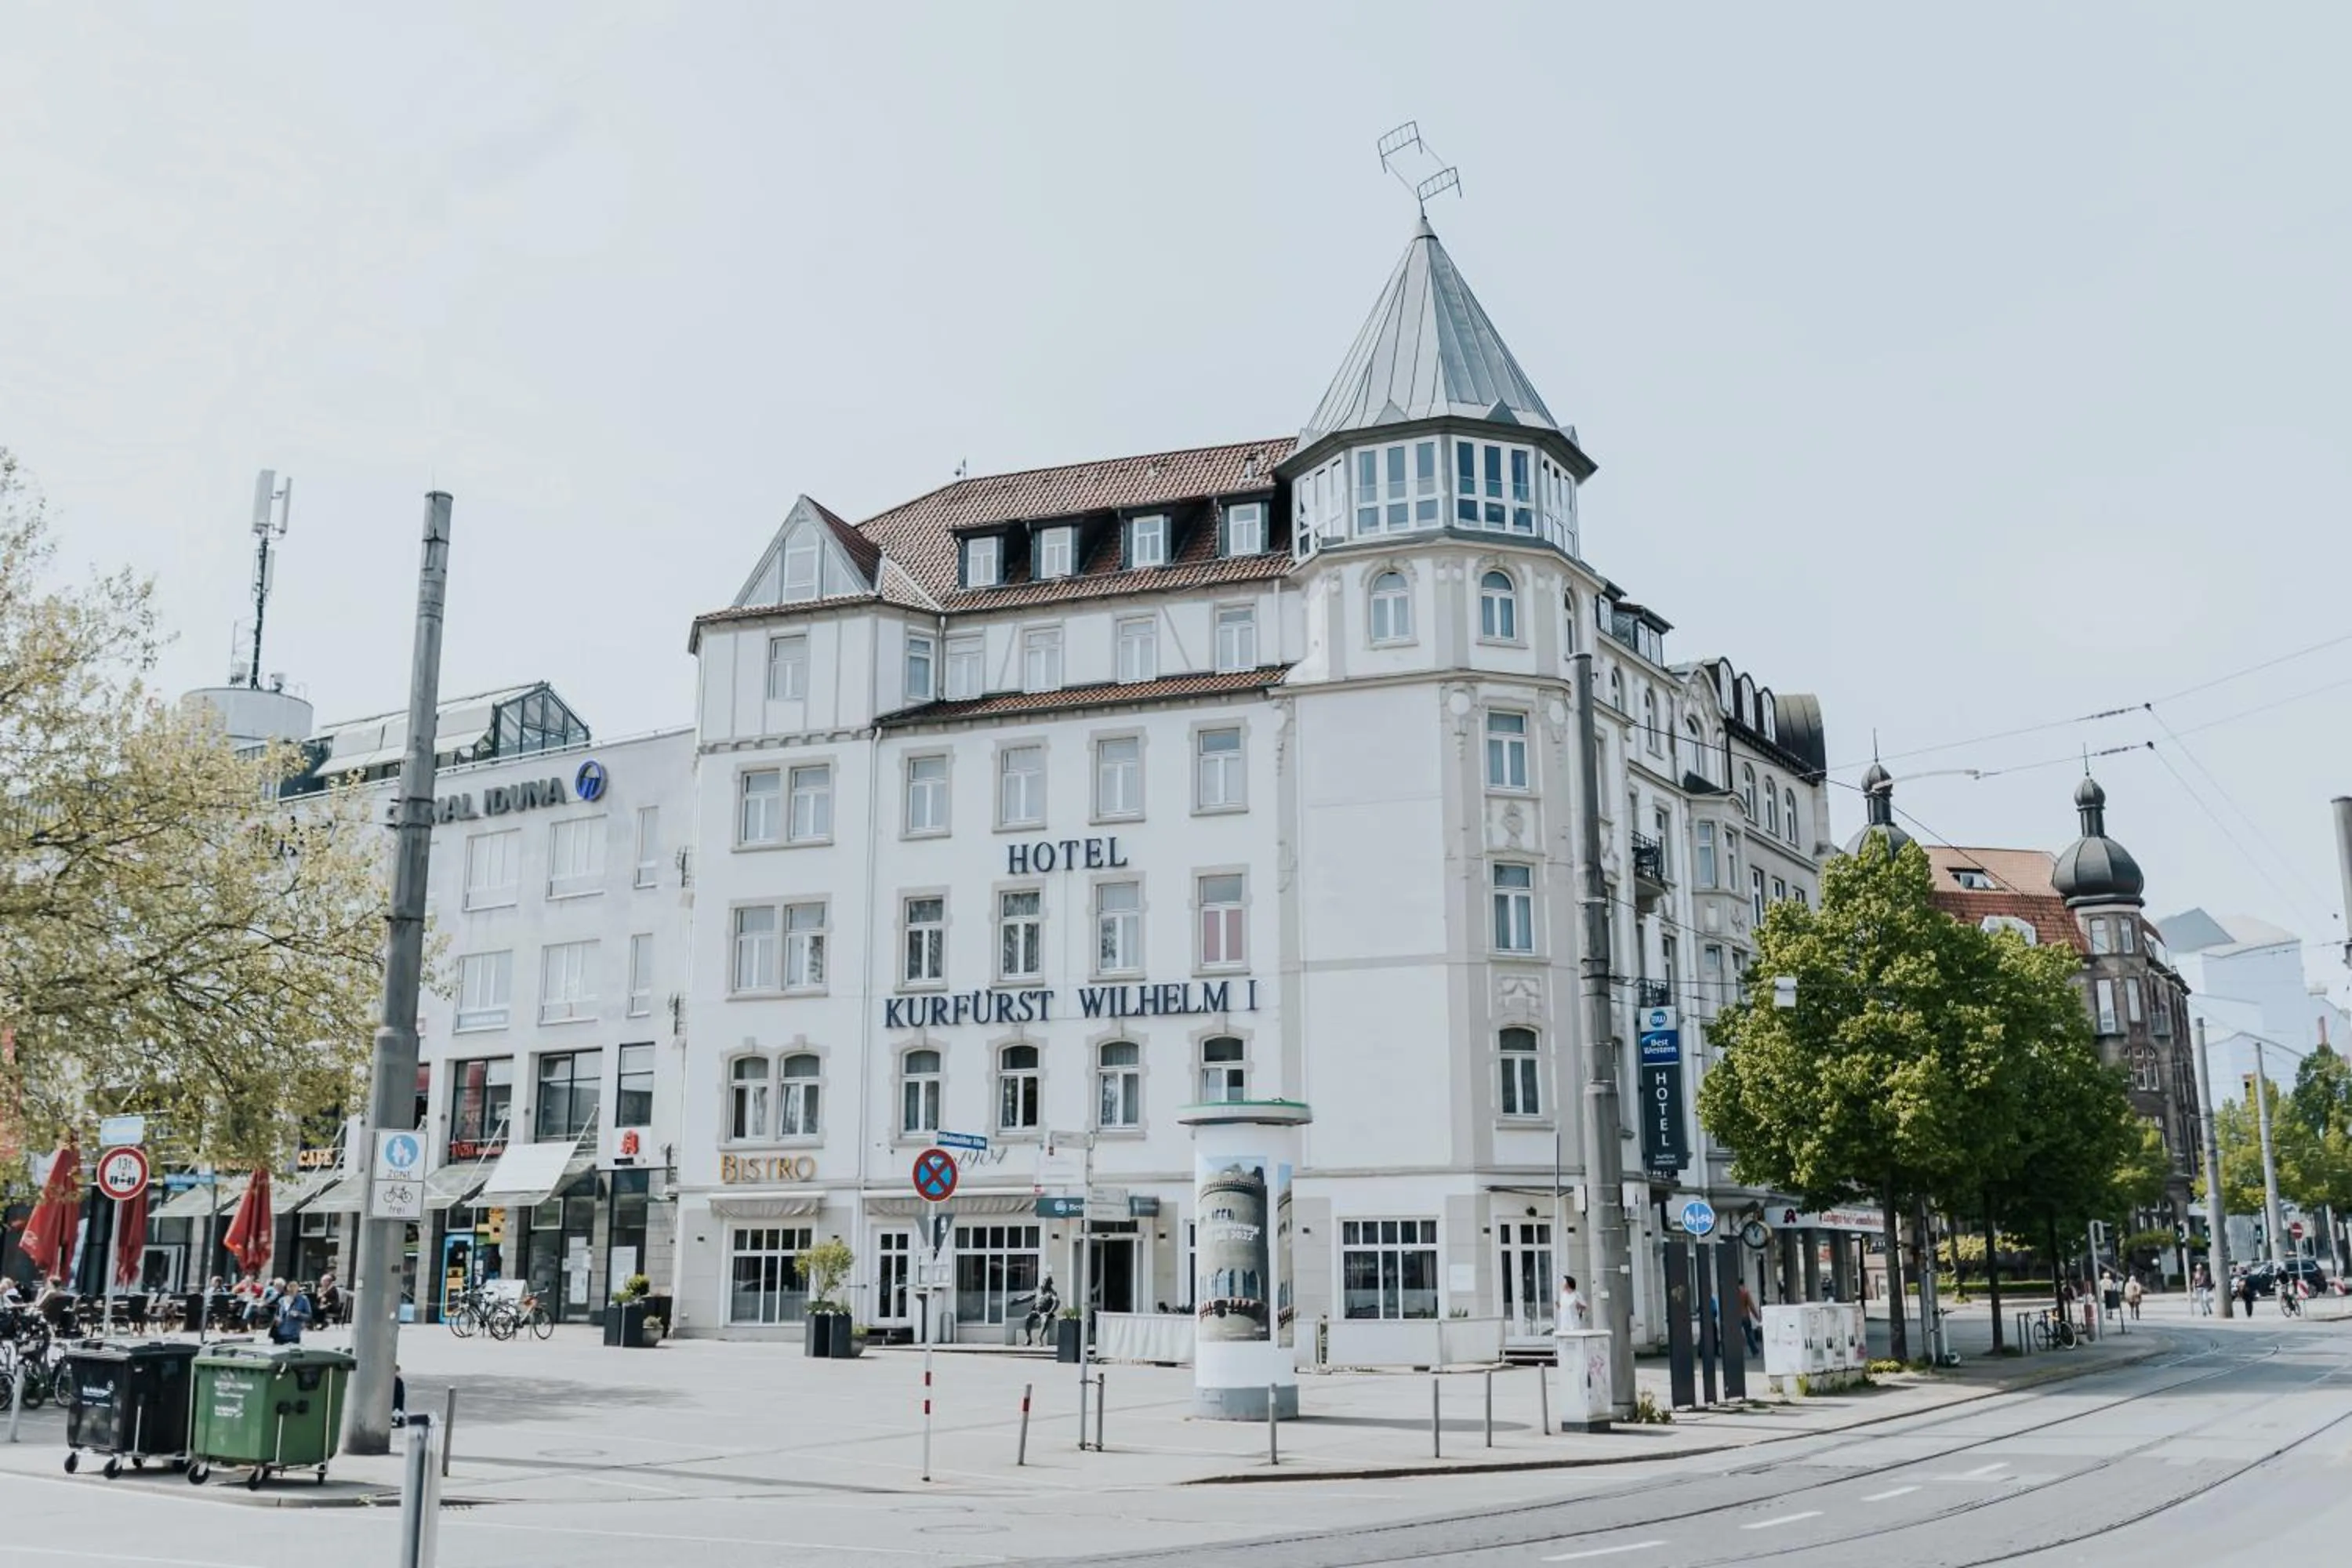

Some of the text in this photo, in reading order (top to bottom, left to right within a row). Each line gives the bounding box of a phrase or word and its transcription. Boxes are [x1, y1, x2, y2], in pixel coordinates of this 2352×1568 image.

[484, 777, 566, 816] IDUNA
[1007, 837, 1128, 874] HOTEL
[884, 979, 1258, 1029] KURFÜRST WILHELM I
[1643, 1046, 1677, 1054] Western
[1650, 1038, 1669, 1047] Best
[1655, 1072, 1671, 1147] HOTEL
[720, 1154, 817, 1184] BISTRO
